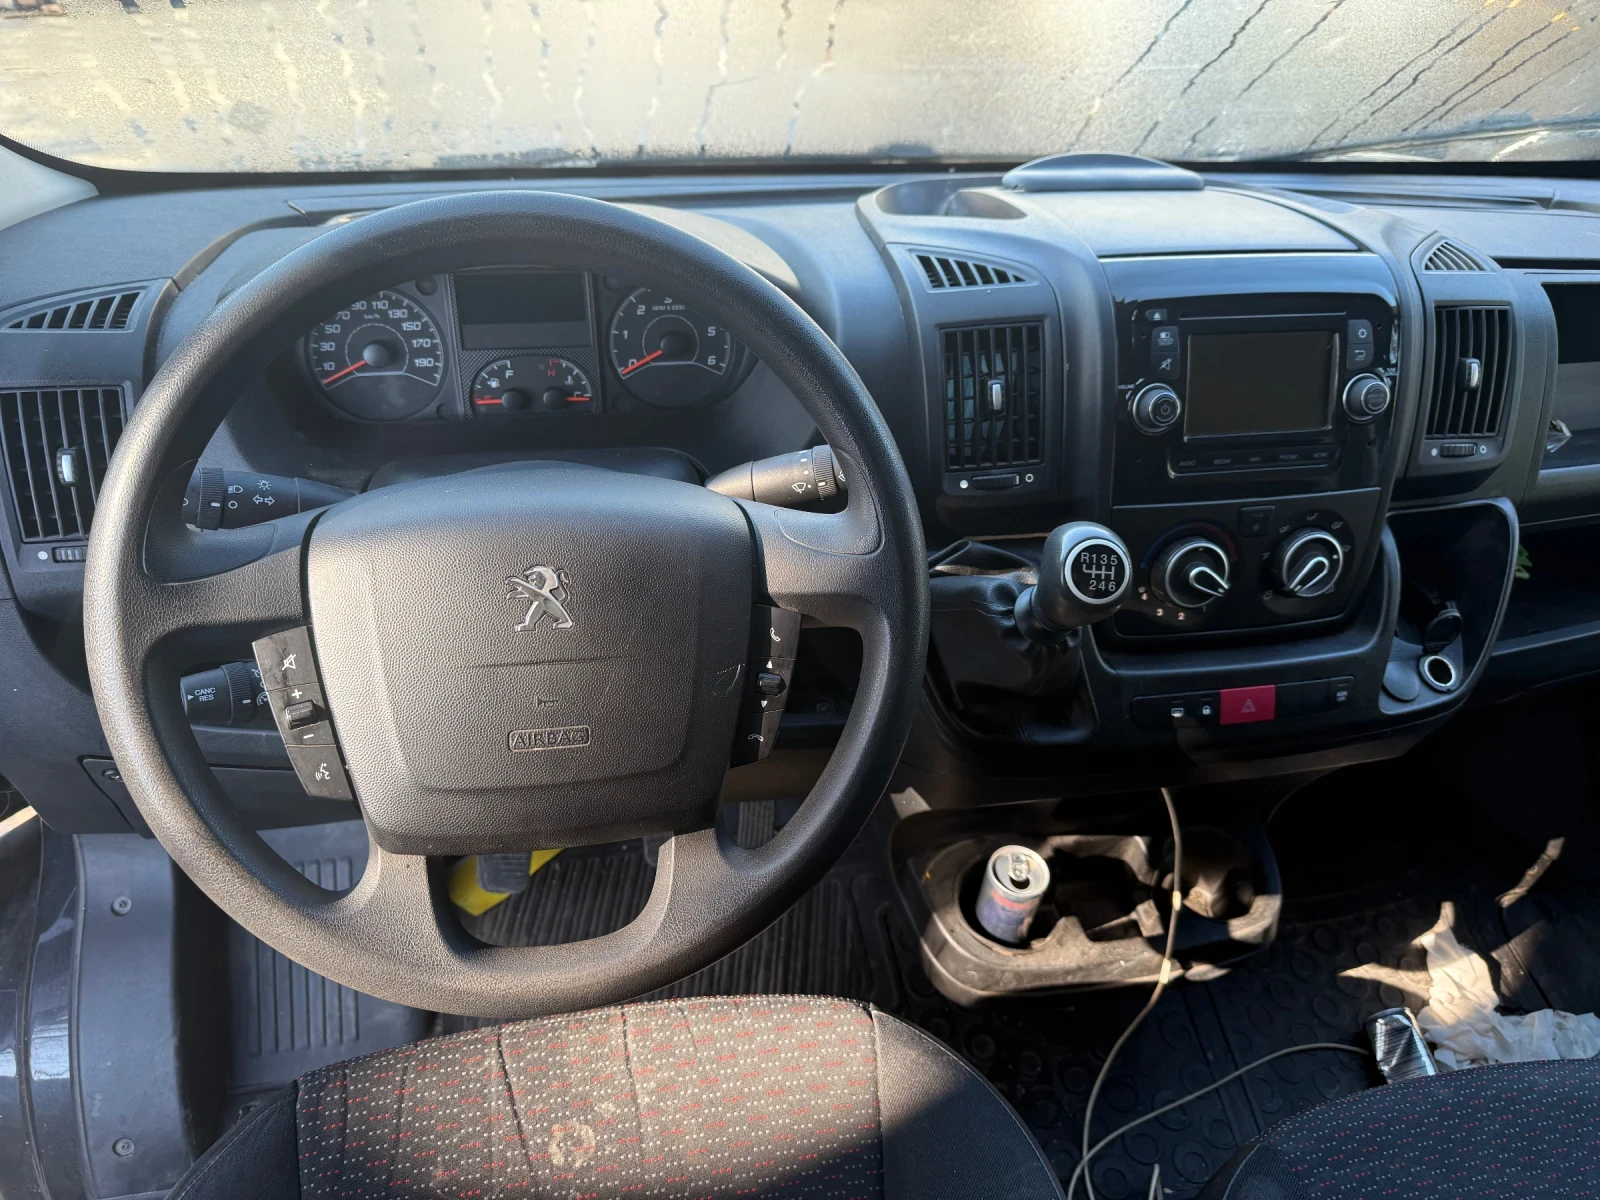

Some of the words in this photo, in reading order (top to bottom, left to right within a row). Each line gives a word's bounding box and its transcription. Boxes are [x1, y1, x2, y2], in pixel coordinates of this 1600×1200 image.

[351, 300, 367, 311] 90
[371, 300, 389, 310] 110
[637, 304, 646, 315] 2
[336, 311, 351, 320] 70
[387, 309, 408, 319] 130
[324, 324, 341, 334] 50
[402, 322, 421, 331] 150
[708, 326, 716, 336] 5
[623, 330, 629, 339] 1
[320, 342, 335, 351] 30
[411, 338, 431, 348] 170
[414, 358, 434, 367] 190
[708, 355, 716, 365] 6
[322, 361, 335, 371] 10
[505, 369, 514, 379] F
[547, 369, 556, 377] H
[1141, 593, 1148, 601] 4
[1156, 608, 1164, 617] 3
[1177, 612, 1186, 620] 2
[194, 687, 216, 696] CANC
[199, 694, 215, 702] RES
[512, 730, 585, 747] AIRBAG
